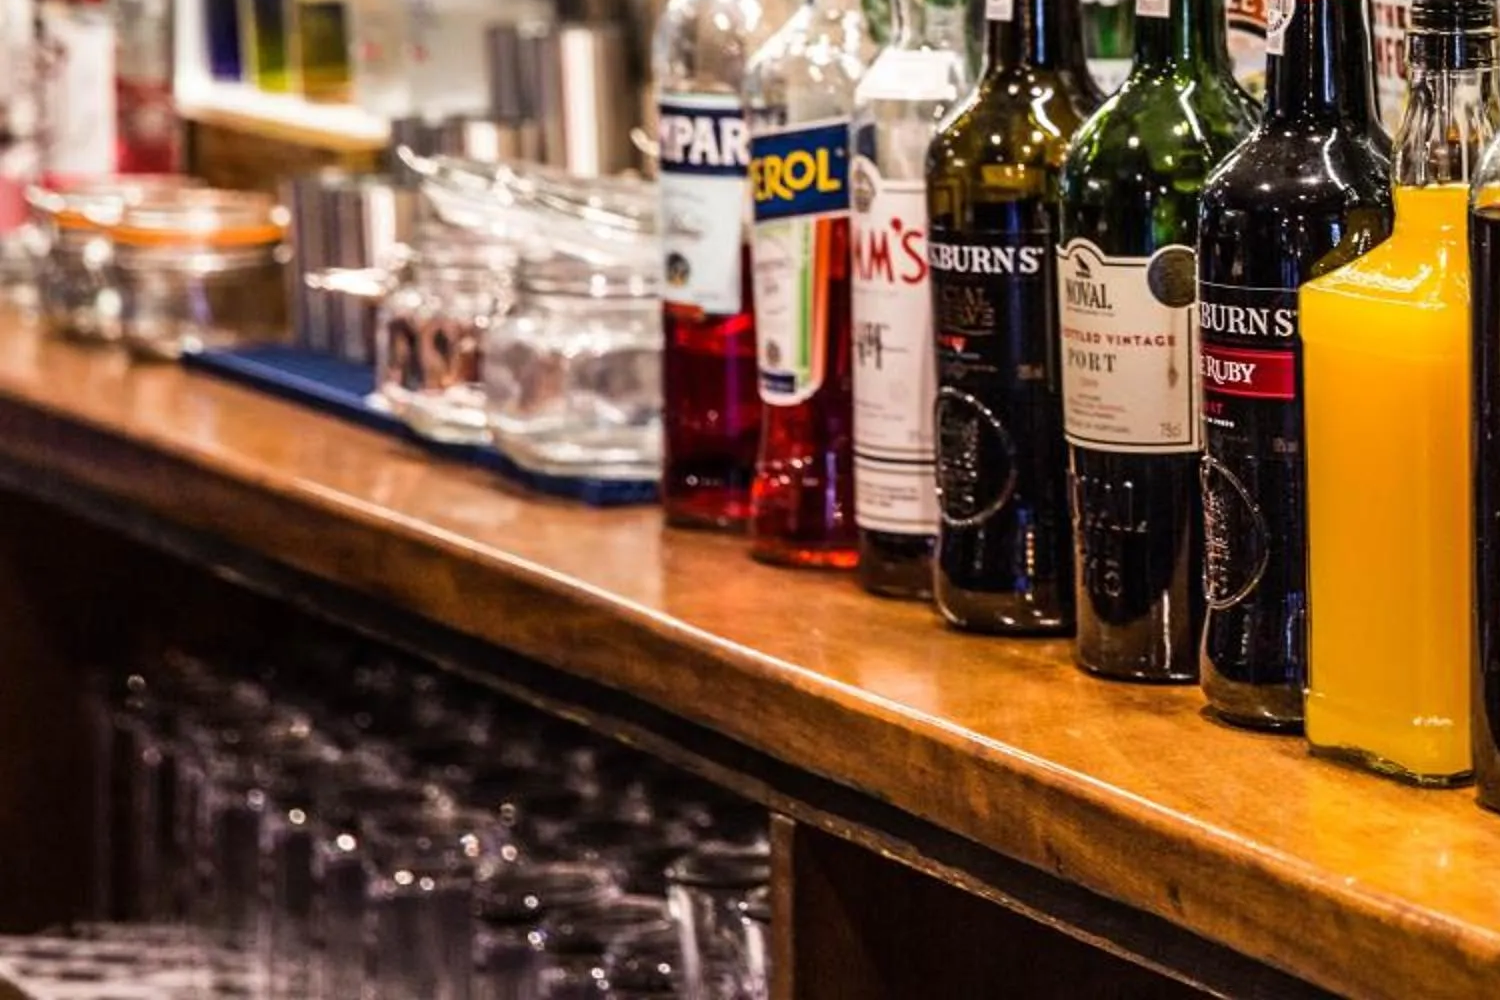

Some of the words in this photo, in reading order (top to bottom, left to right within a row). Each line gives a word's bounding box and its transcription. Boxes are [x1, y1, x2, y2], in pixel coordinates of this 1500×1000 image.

[1106, 334, 1176, 347] VINTAGE
[1068, 347, 1117, 373] PORT
[1207, 355, 1257, 385] RUBY
